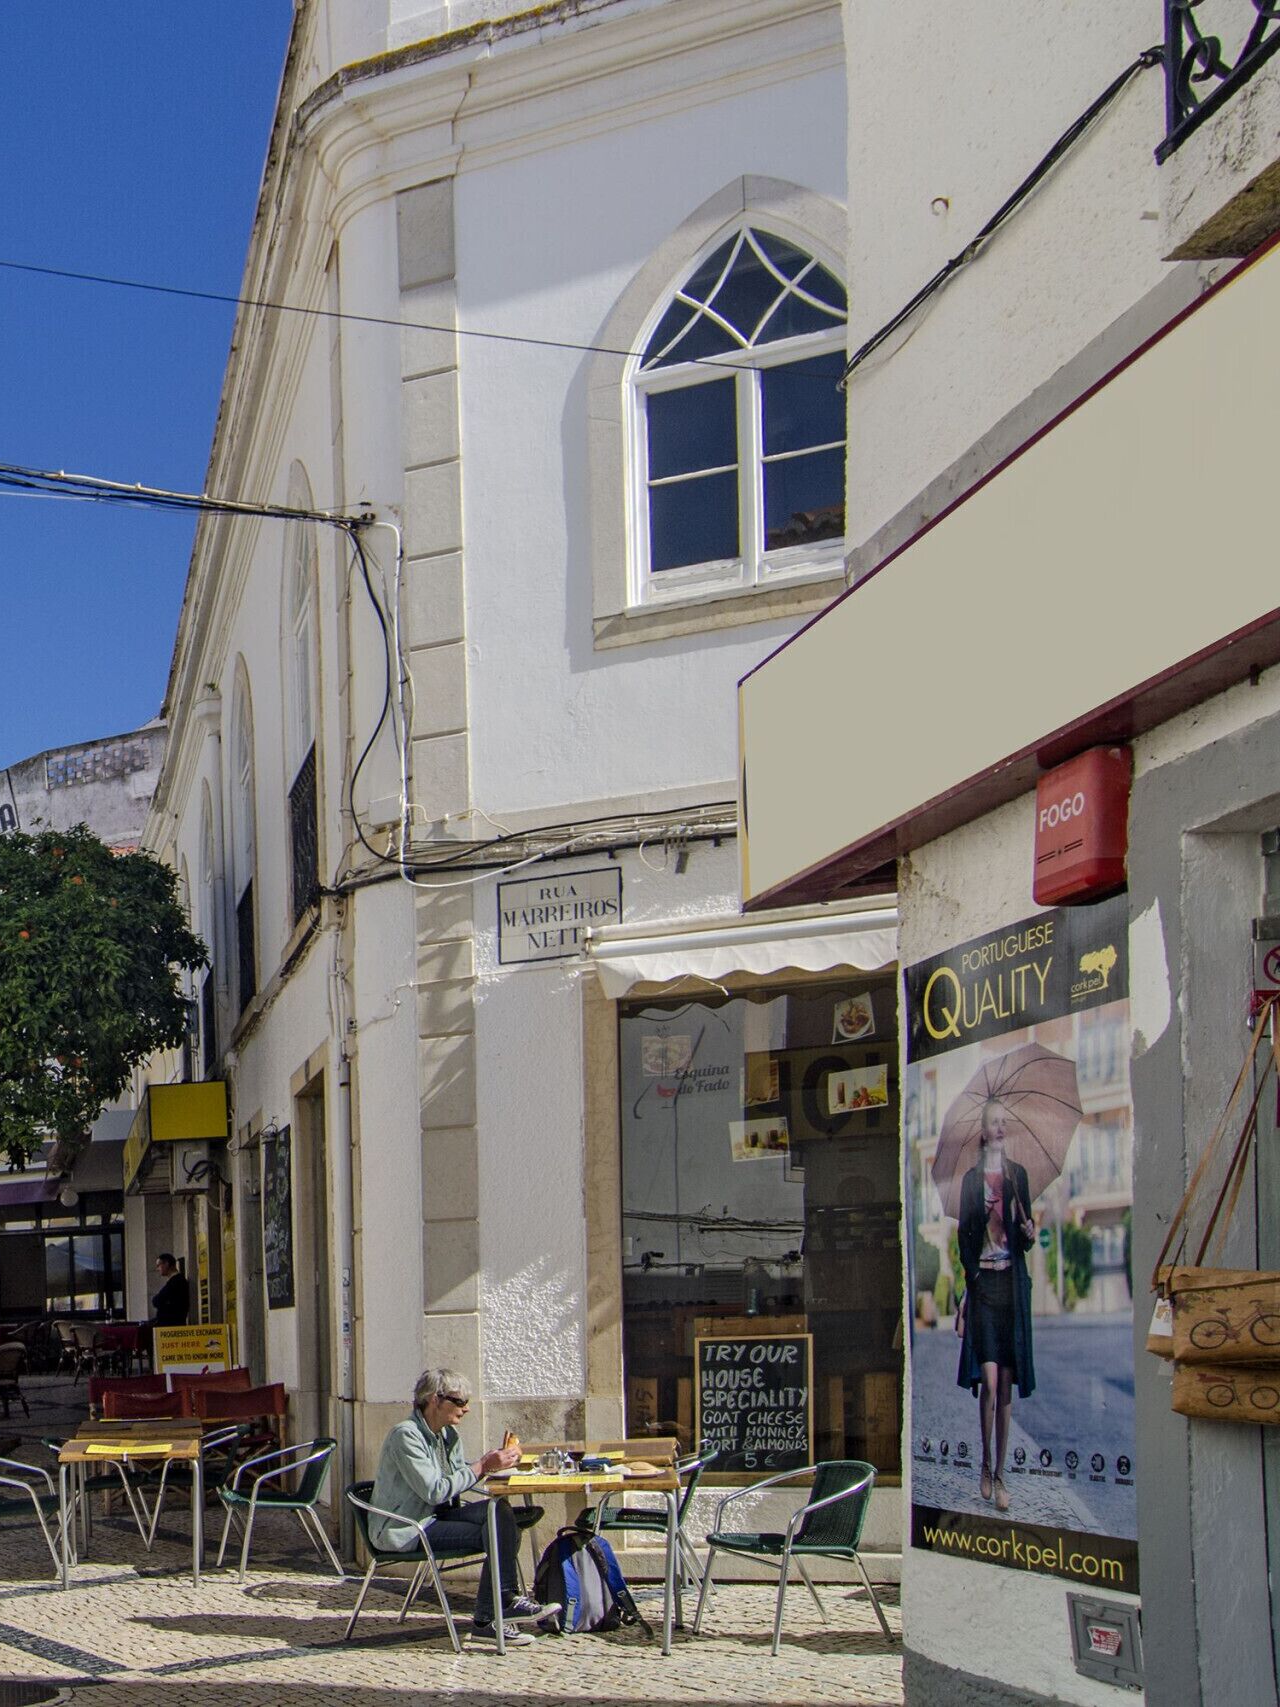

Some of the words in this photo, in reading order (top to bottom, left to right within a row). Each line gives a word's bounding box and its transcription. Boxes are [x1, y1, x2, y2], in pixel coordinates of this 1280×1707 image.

[1039, 792, 1085, 832] FOGO
[540, 885, 577, 900] RUA
[504, 898, 618, 927] MARREIROS
[528, 927, 586, 948] NETT
[962, 921, 1054, 974] PORTUGUESE
[923, 956, 1053, 1040] QUALITY
[704, 1345, 746, 1362] TRY
[749, 1344, 798, 1364] OUR
[701, 1367, 765, 1389] HOUSE
[702, 1386, 808, 1409] SPECIALITY
[702, 1410, 741, 1425] GOAT
[747, 1410, 804, 1425] CHEESE
[702, 1426, 738, 1437] WITH
[703, 1438, 740, 1450] PORT
[744, 1453, 757, 1468] 5
[764, 1453, 776, 1467] €
[923, 1525, 1124, 1581] www.corkpel.com
